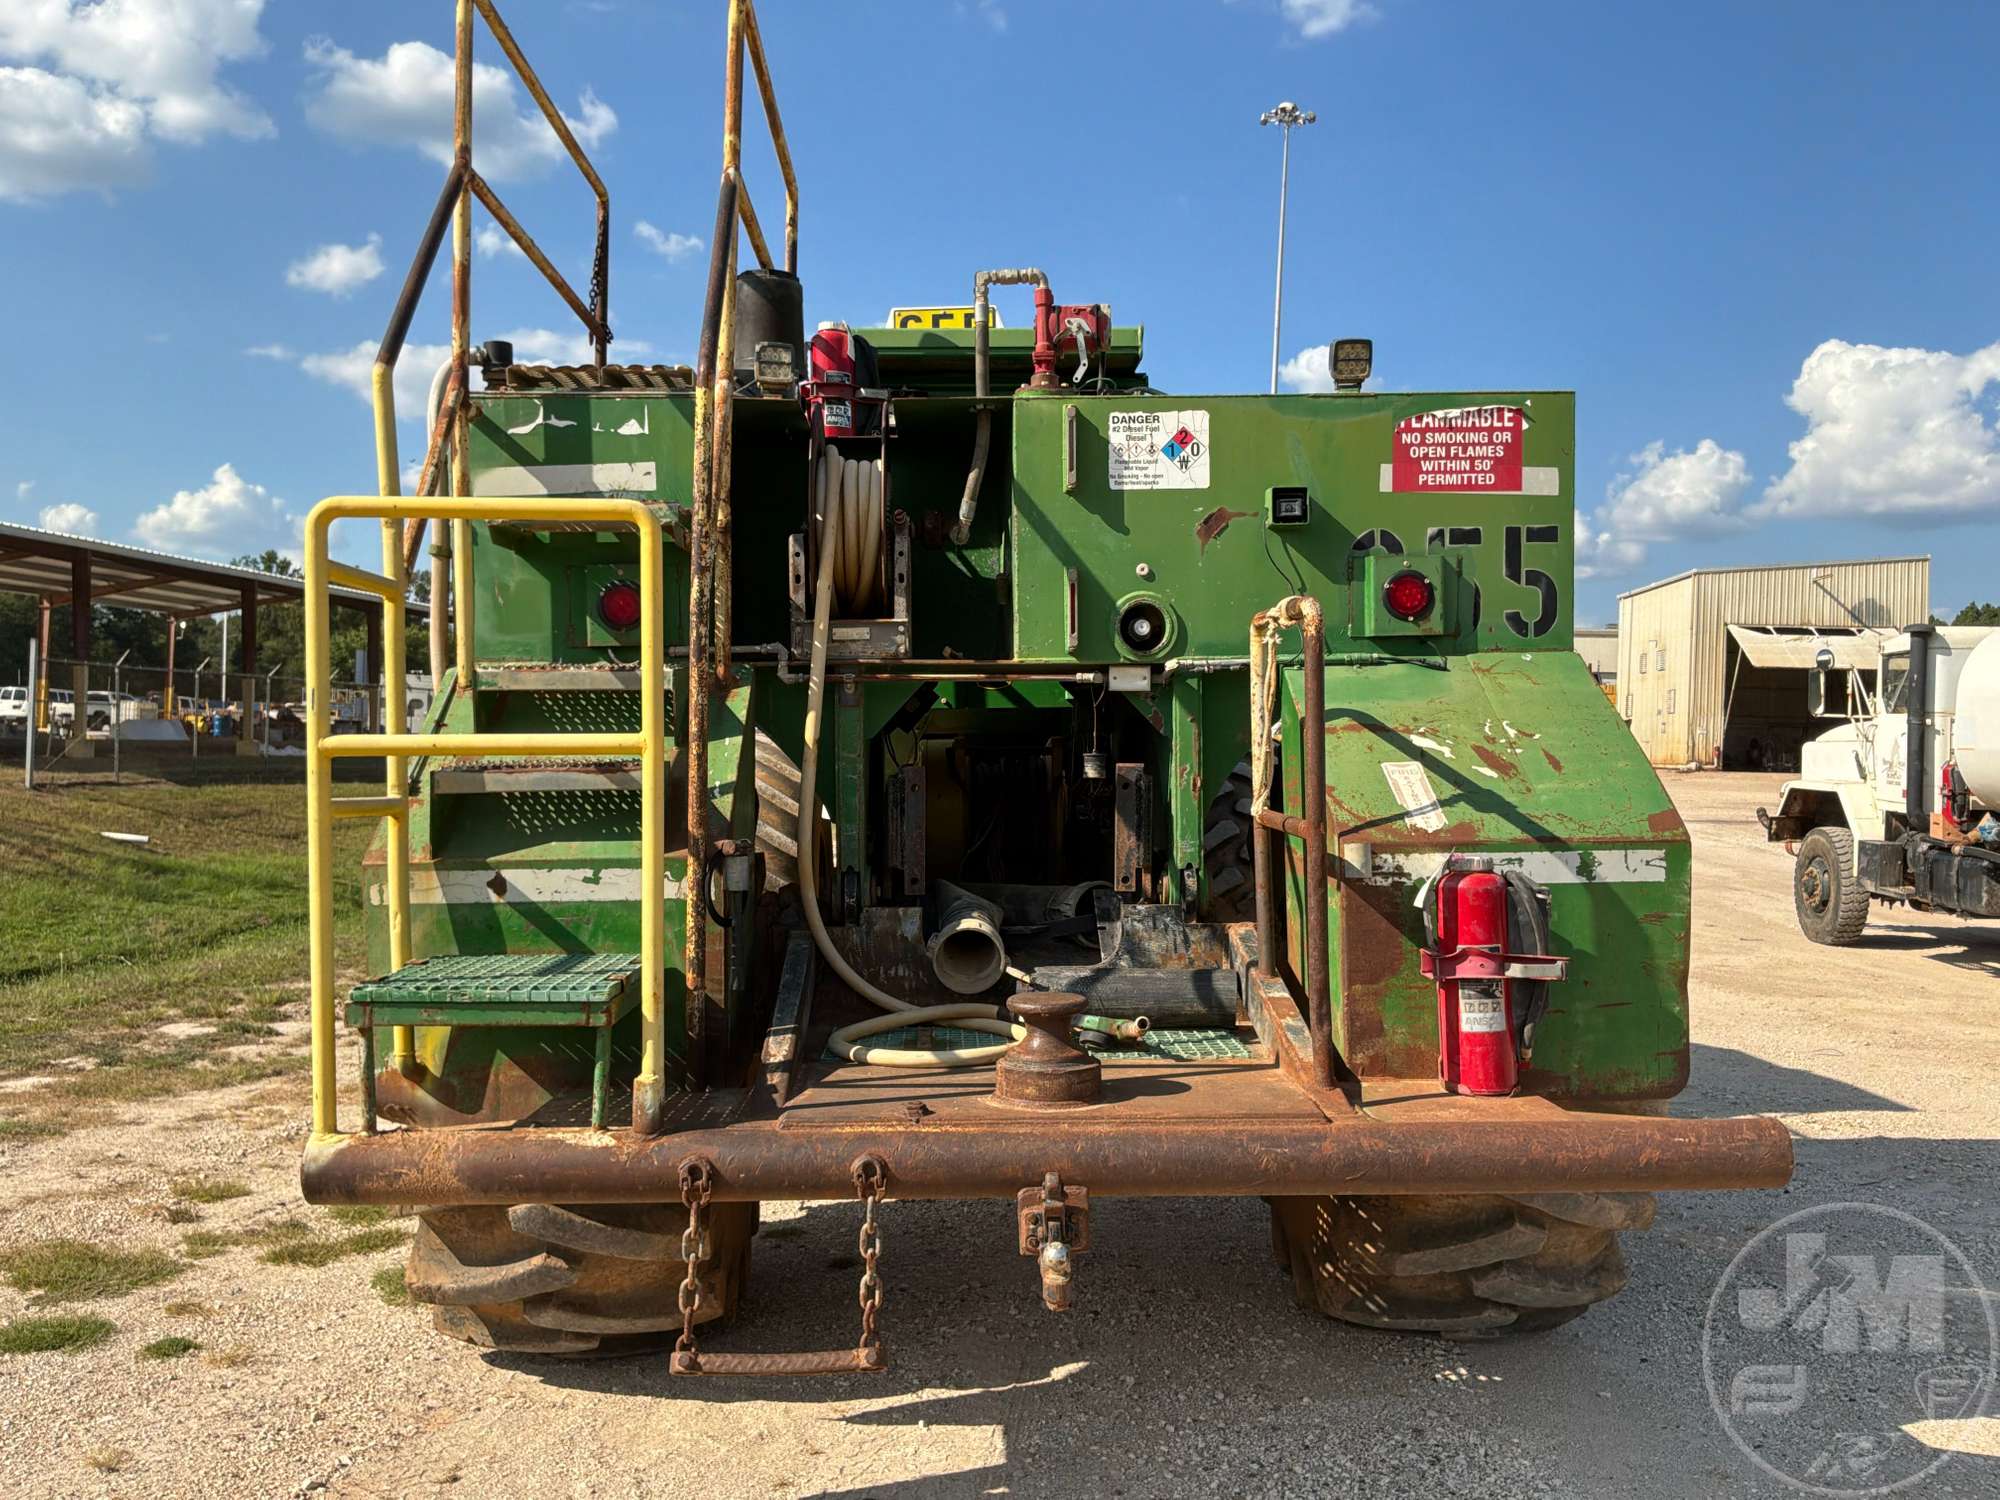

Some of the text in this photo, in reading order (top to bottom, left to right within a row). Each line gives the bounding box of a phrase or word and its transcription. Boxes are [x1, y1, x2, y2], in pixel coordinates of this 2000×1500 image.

[1112, 415, 1160, 424] DANGER
[1179, 430, 1188, 444] 2
[1401, 432, 1512, 444] NO SMOKING OR
[1168, 442, 1200, 457] 1 0
[1410, 446, 1504, 458] OPEN FLAMES
[1421, 460, 1494, 471] WITHIN 50'
[1419, 474, 1495, 485] PERMITTED
